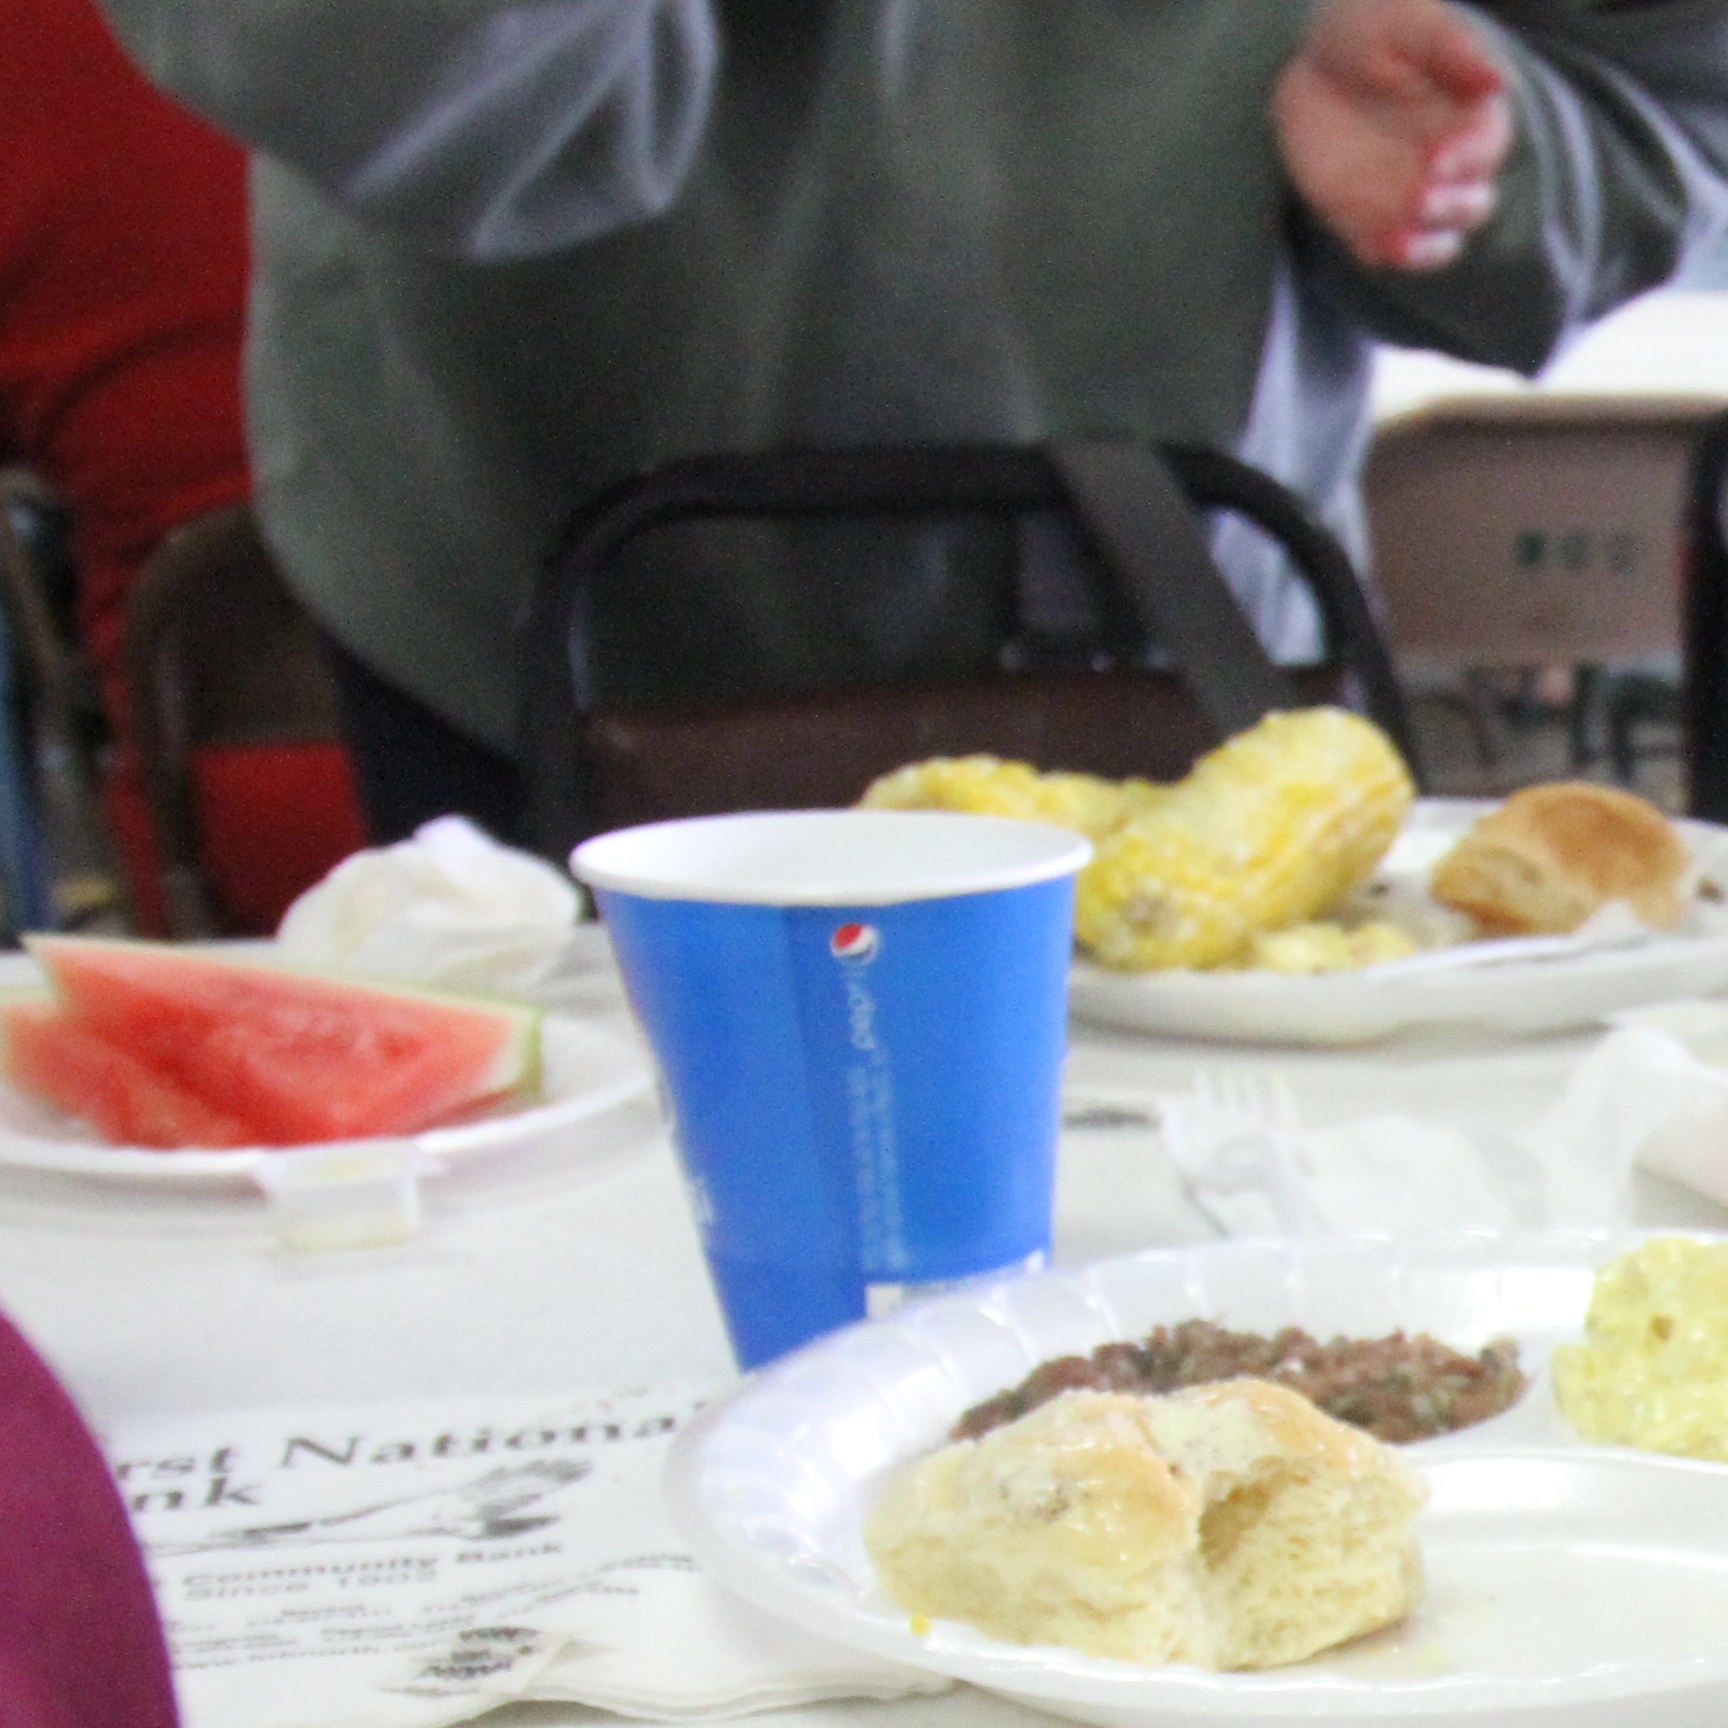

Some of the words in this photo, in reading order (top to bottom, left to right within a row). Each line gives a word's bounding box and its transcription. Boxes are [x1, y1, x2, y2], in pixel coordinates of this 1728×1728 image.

[113, 1445, 238, 1480] rst
[128, 1475, 263, 1512] nk
[183, 1556, 439, 1586] Community
[456, 1541, 562, 1564] Bank
